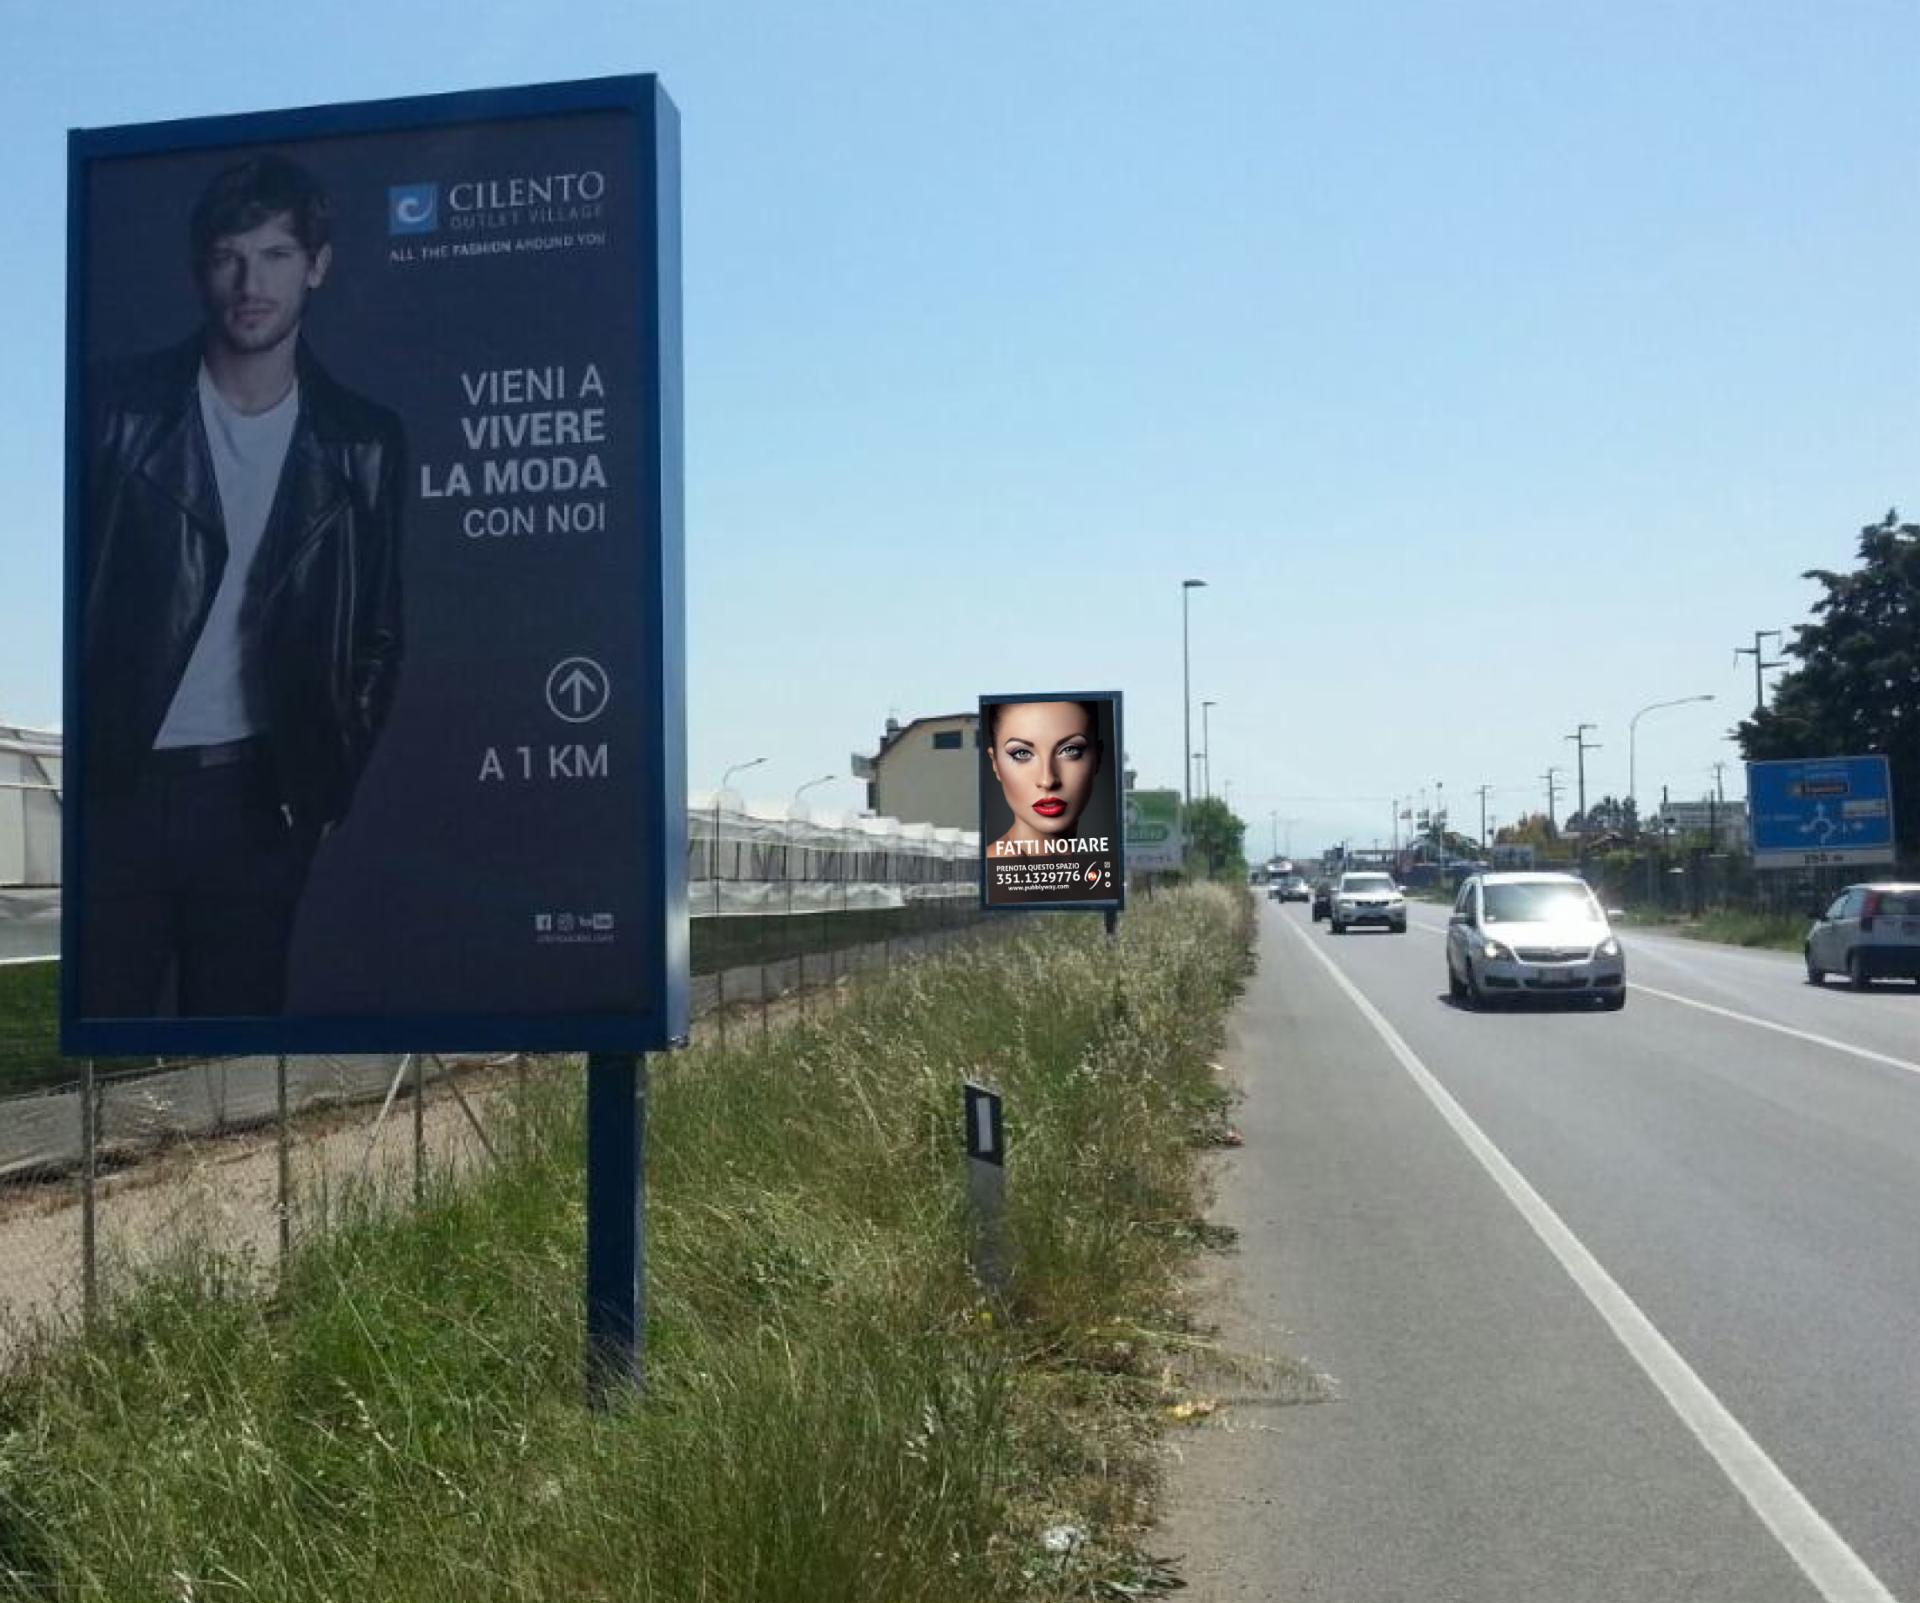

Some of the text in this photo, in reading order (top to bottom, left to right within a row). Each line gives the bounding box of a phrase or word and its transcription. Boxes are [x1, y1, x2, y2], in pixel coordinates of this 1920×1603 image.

[449, 171, 605, 211] CILENTO
[390, 232, 606, 262] ALL THE FASHION AROUND YOU
[460, 363, 605, 406] VIENI A
[461, 408, 606, 450] VIVERE
[420, 453, 608, 498] LA MODA
[463, 502, 606, 538] CON NOI
[478, 743, 609, 781] A 1 KM
[995, 837, 1109, 856] FATTI NOTARE
[996, 871, 1081, 885] 351.1329776
[1027, 862, 1055, 871] QUESTO
[1056, 862, 1080, 870] SPAZIO
[1008, 884, 1069, 892] www.pubblyway.com
